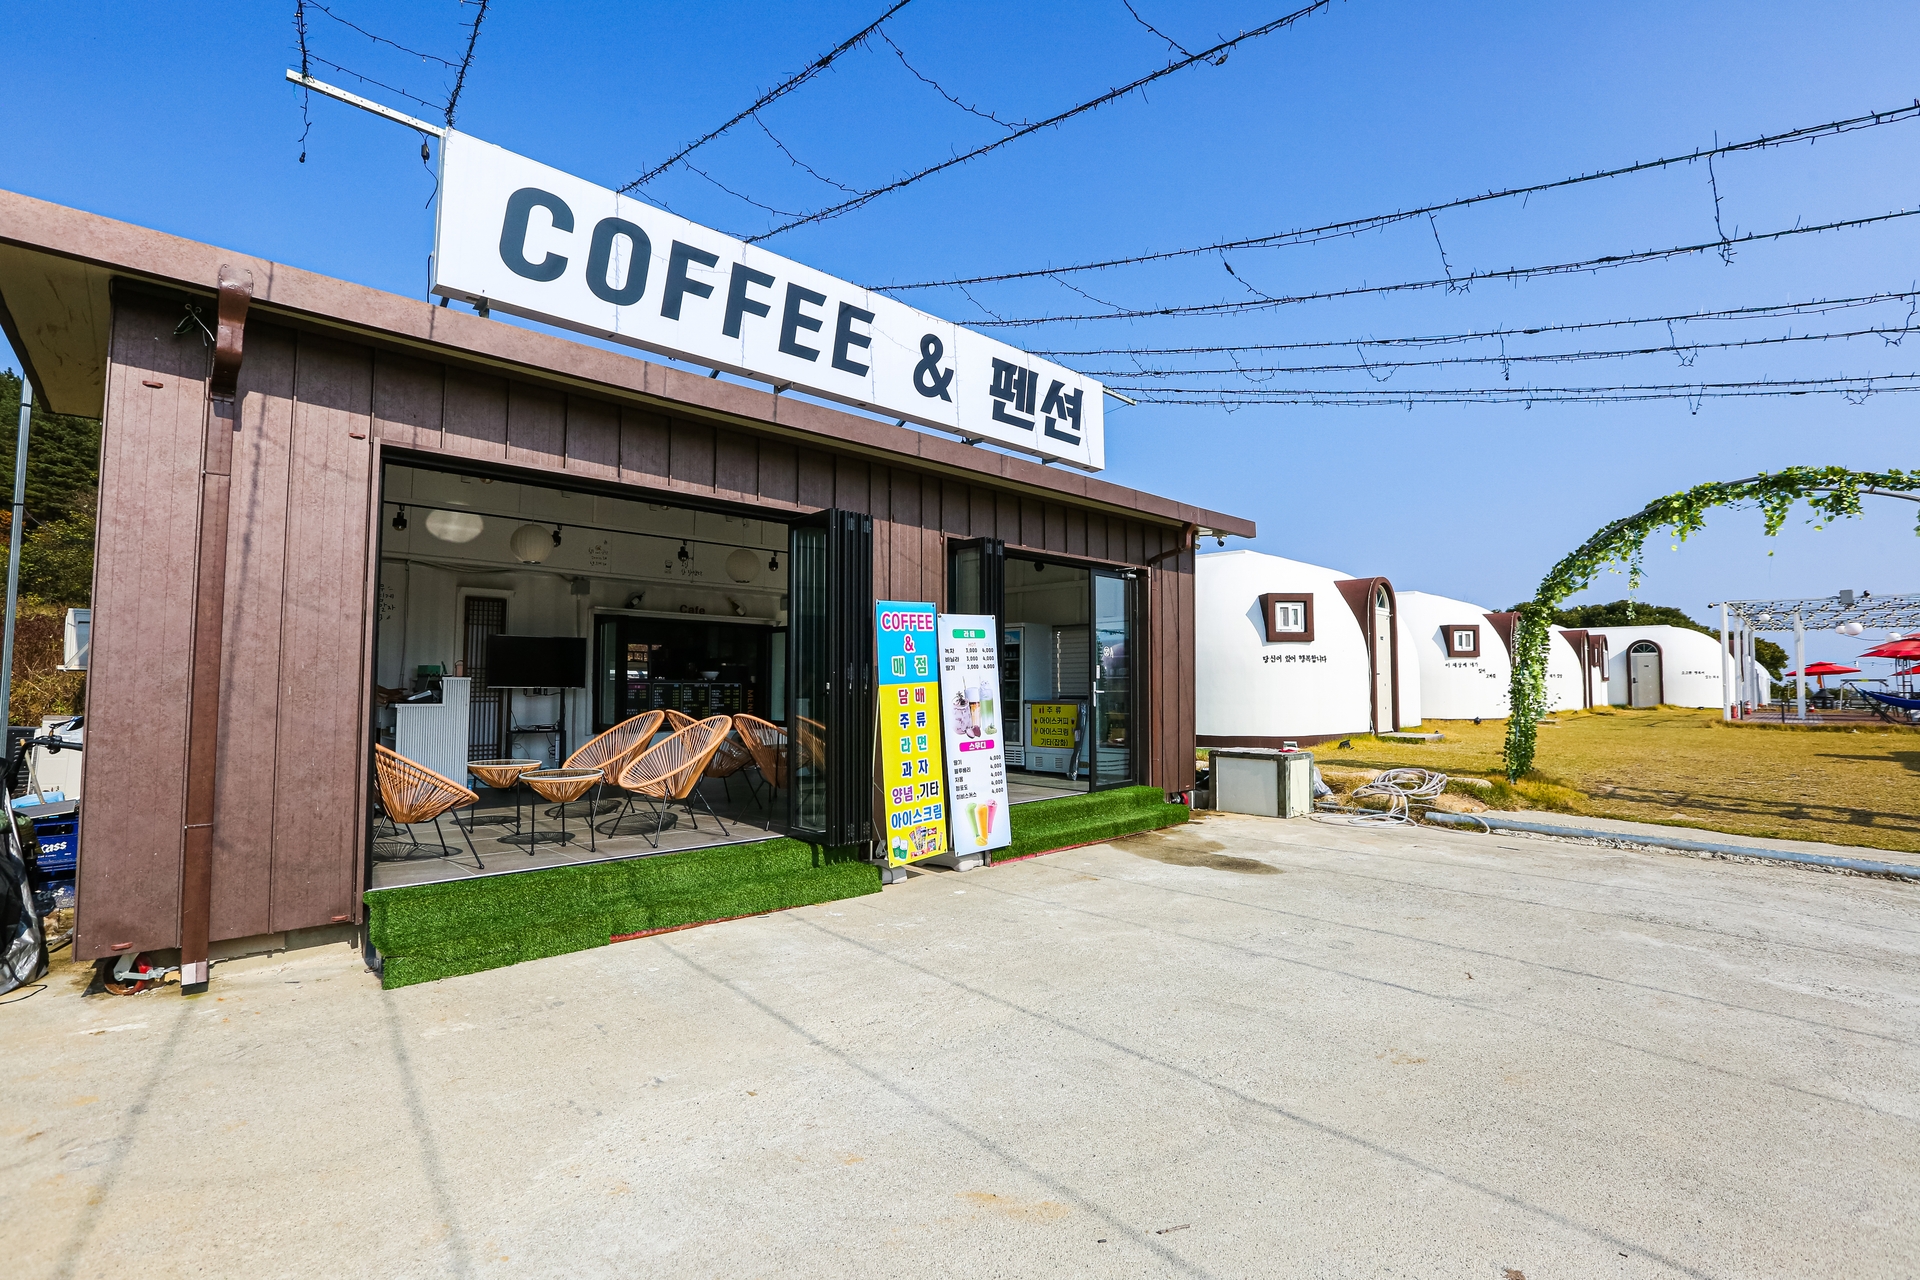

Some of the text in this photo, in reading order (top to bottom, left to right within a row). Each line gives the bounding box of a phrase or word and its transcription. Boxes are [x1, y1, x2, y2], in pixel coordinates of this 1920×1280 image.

[498, 187, 1084, 446] COFFEE & 펜션
[680, 604, 706, 614] Cafe
[882, 612, 933, 630] COFFEE
[904, 635, 914, 652] &
[1298, 655, 1327, 663] 행복합니다
[968, 742, 986, 750] 스무디
[1041, 738, 1068, 746] 기타(잡화)
[891, 804, 942, 829] 아이스크림
